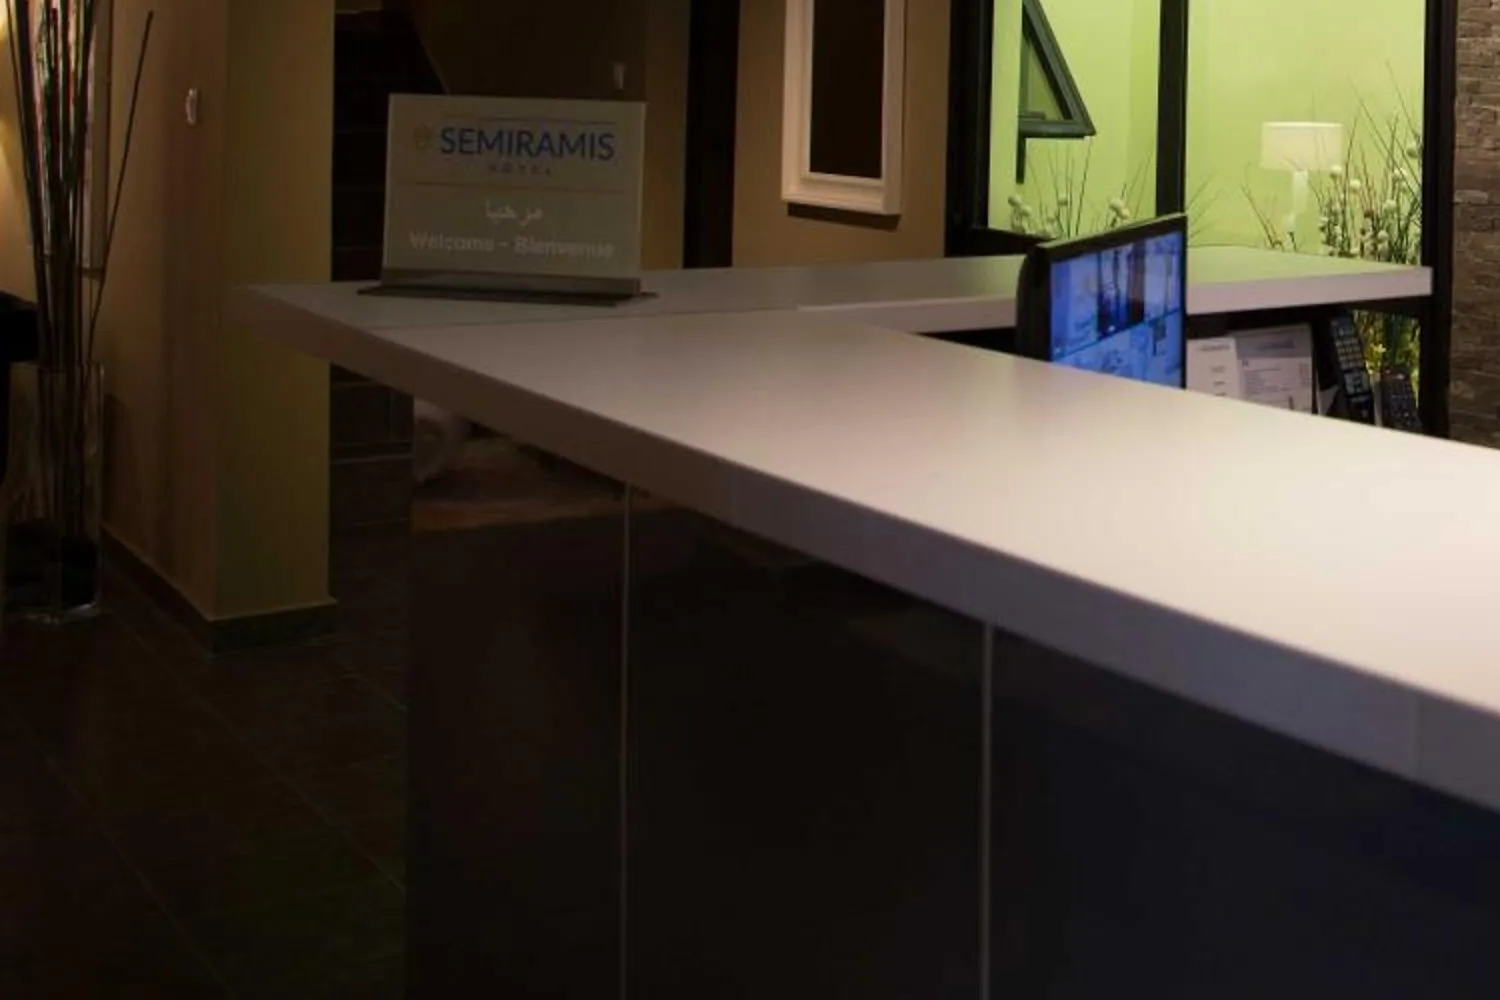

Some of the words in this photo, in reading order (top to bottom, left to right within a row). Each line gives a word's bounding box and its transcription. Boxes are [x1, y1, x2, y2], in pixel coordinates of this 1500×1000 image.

[440, 126, 616, 161] SEMIRAMIS
[408, 228, 495, 252] Welcome
[514, 234, 616, 259] Bienvenue
